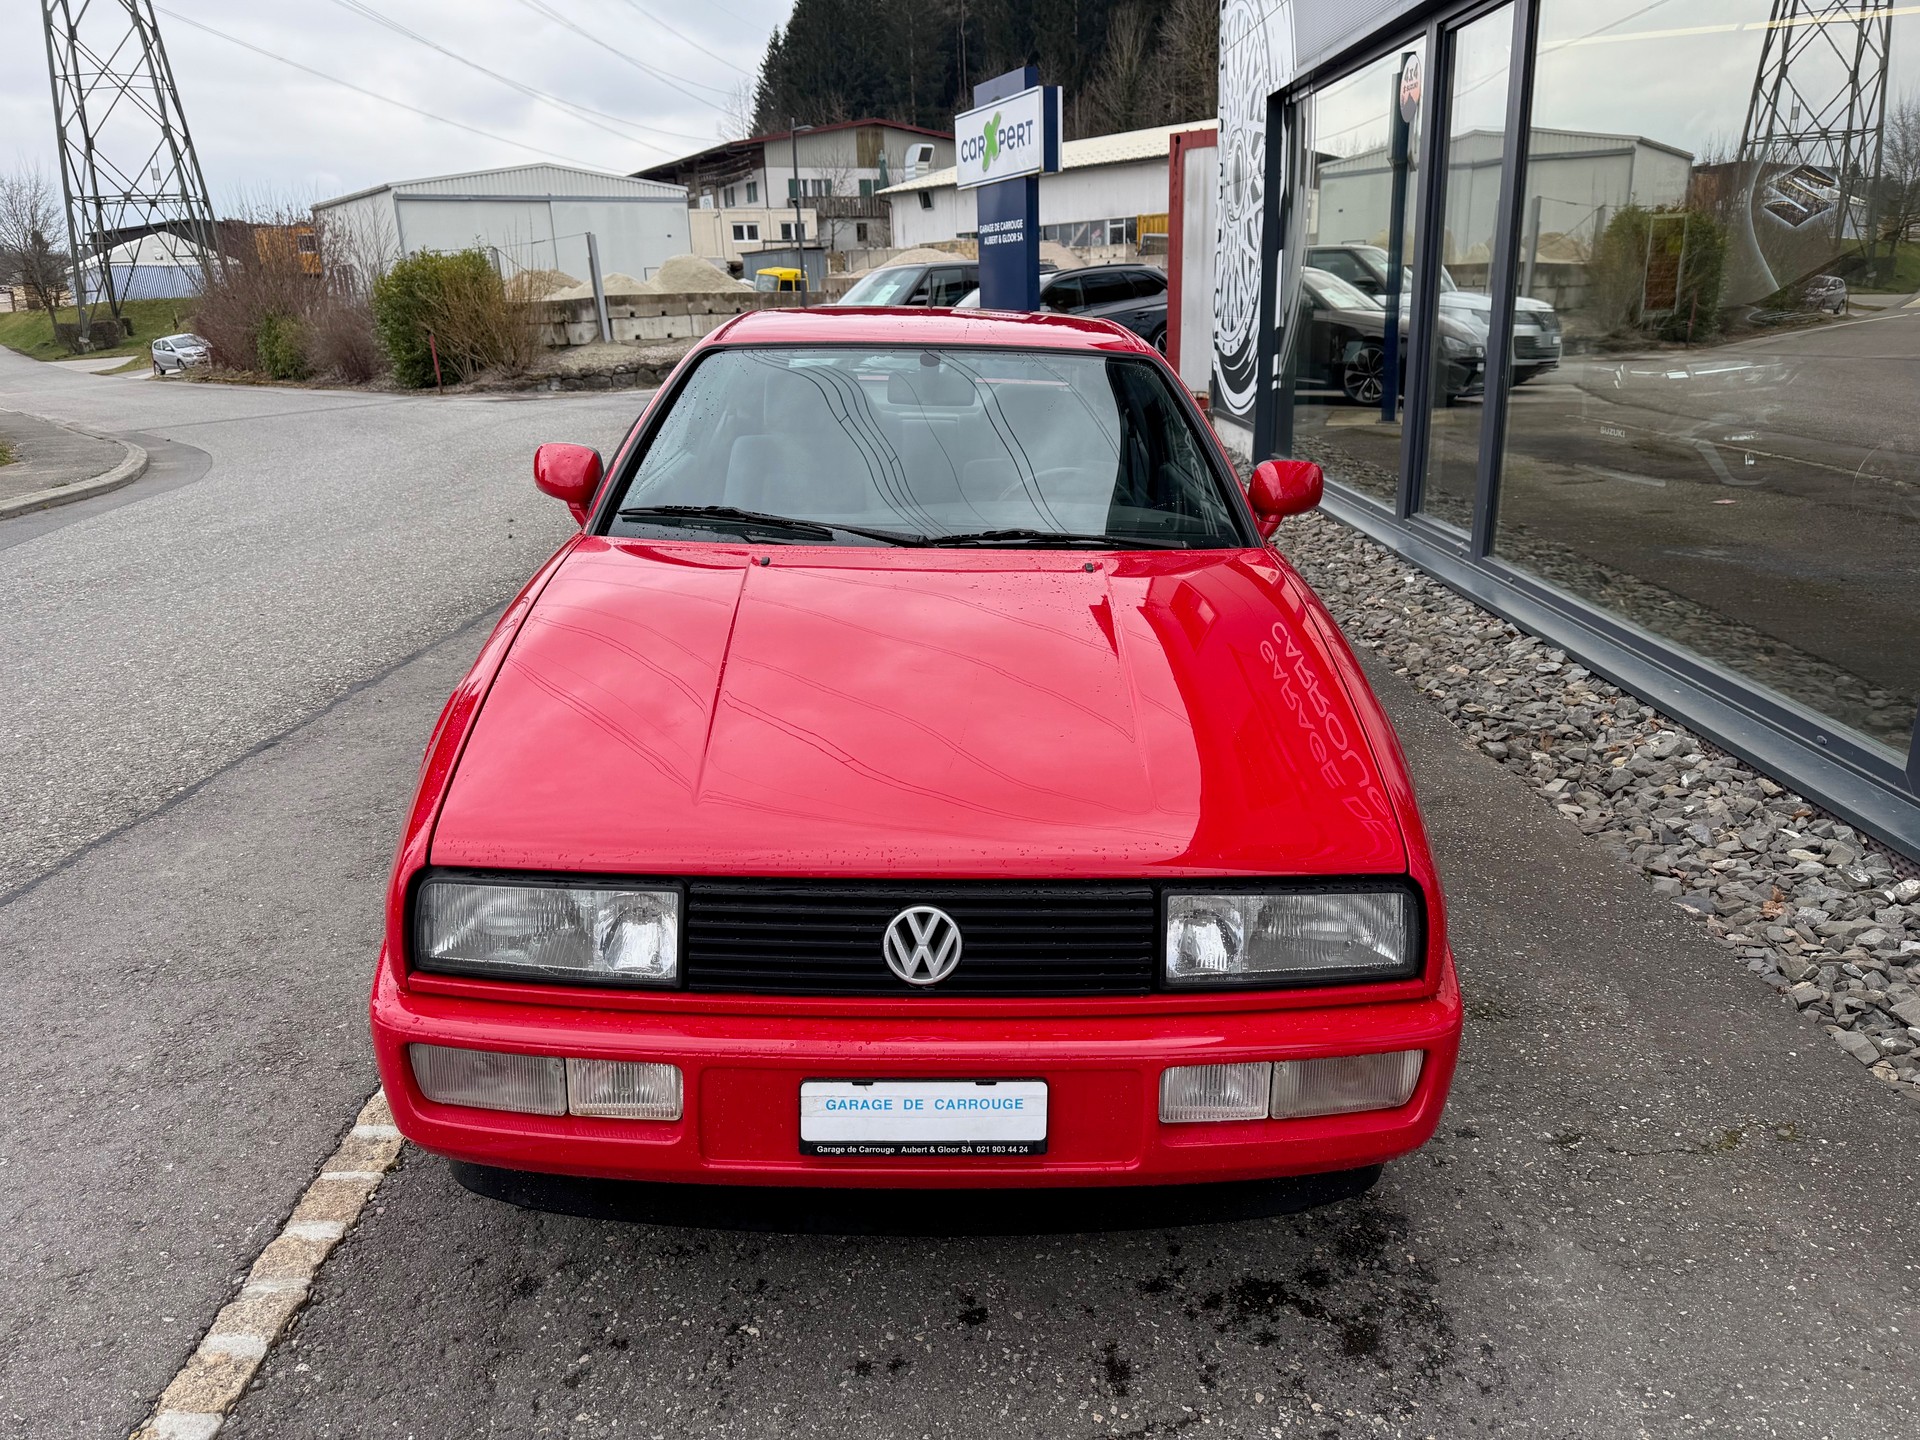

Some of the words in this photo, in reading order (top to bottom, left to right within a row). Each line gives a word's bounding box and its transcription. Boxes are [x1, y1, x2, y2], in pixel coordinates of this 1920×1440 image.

[979, 223, 995, 235] GARAGE
[1000, 219, 1024, 231] CARROUGE
[984, 234, 999, 246] AUBERT
[1600, 426, 1626, 438] SUZUKI
[885, 907, 961, 983] VW
[825, 1098, 893, 1111] GARAGE
[903, 1098, 924, 1111] DE
[934, 1098, 1024, 1111] CARROUGE
[817, 1145, 846, 1155] Garage
[847, 1145, 857, 1154] de
[858, 1145, 895, 1155] Carrouge
[901, 1145, 928, 1154] Aubert
[930, 1145, 936, 1154] &
[937, 1145, 959, 1154] Gloor
[961, 1145, 973, 1154] SA
[976, 1145, 990, 1154] 021
[991, 1145, 1006, 1154] 903
[1007, 1145, 1018, 1154] 44
[1019, 1145, 1029, 1154] 24
